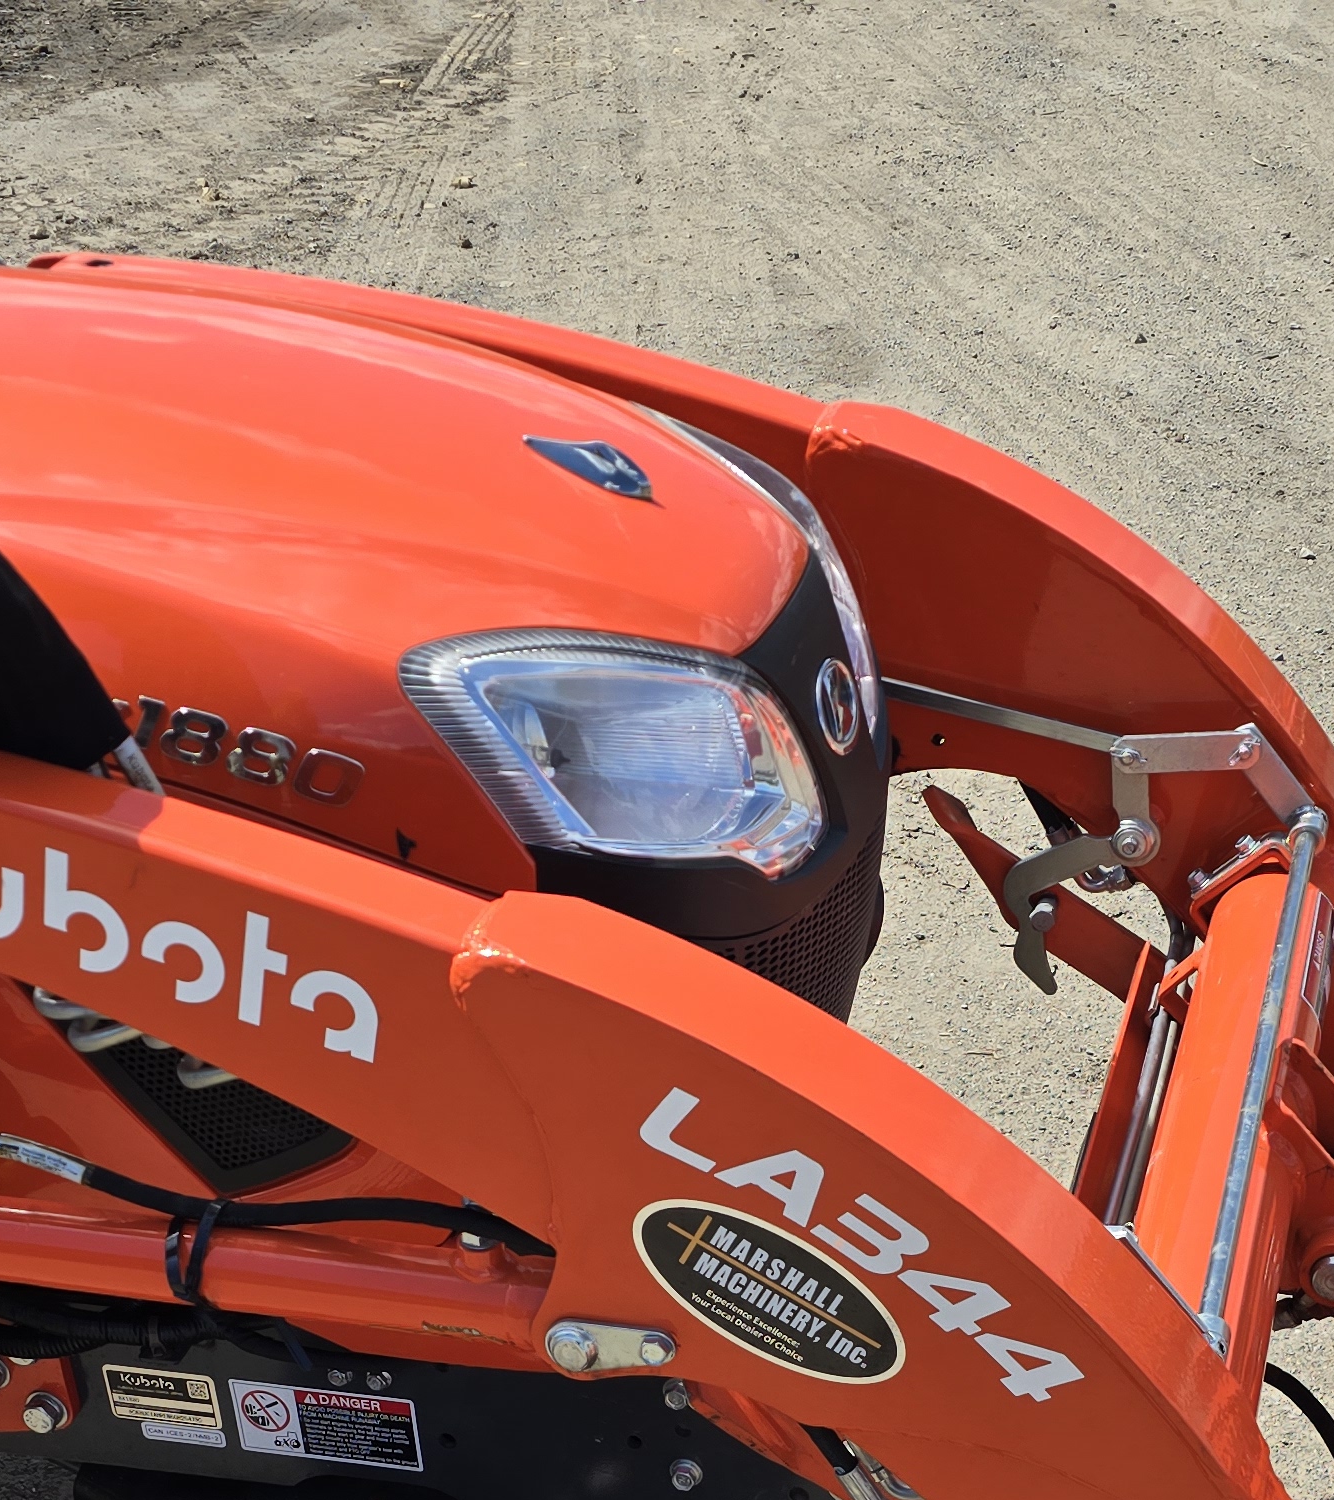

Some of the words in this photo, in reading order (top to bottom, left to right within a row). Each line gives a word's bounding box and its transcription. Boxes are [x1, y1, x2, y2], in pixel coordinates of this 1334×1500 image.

[112, 695, 366, 807] 1880
[639, 1087, 1085, 1402] LA344
[709, 1225, 844, 1316] MARSHALL
[692, 1292, 711, 1308] Your
[711, 1305, 735, 1322] Local
[734, 1319, 764, 1339] Dealer
[764, 1335, 776, 1345] Of
[774, 1342, 804, 1362] Choice
[693, 1252, 827, 1343] MACHINERY,
[825, 1329, 868, 1369] Inc.
[706, 1290, 752, 1320] Experience
[120, 1373, 175, 1390] Kubota
[319, 1395, 380, 1411] DANGER
